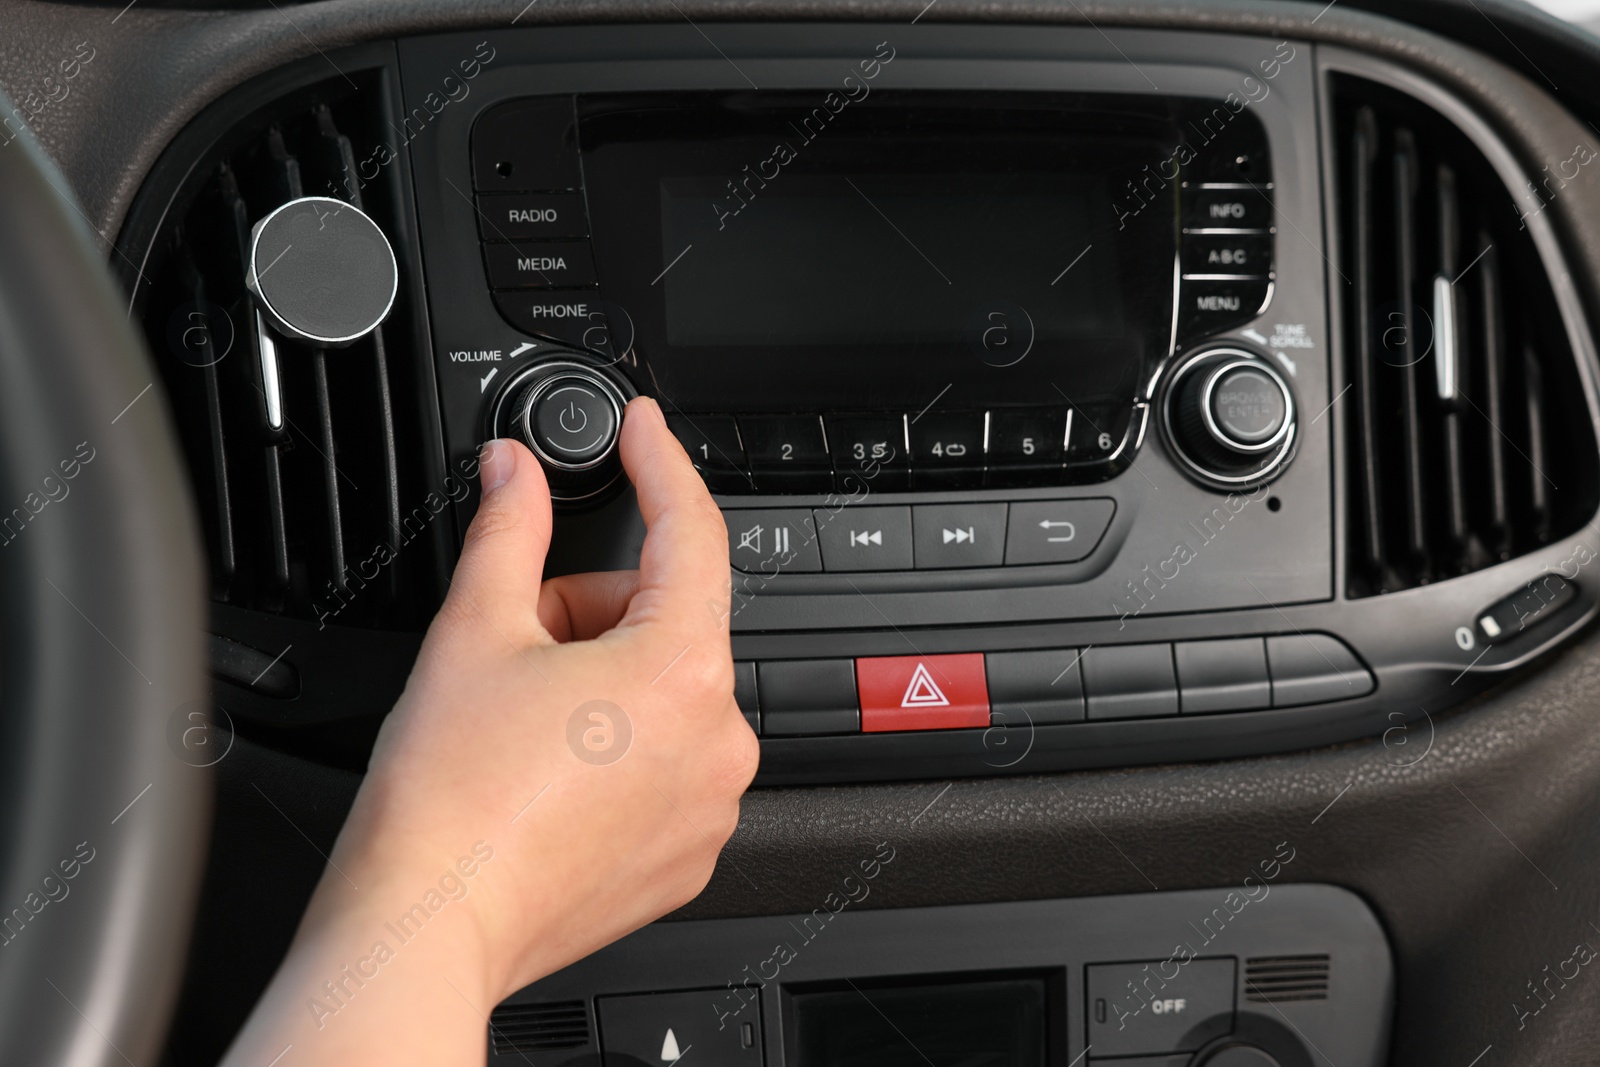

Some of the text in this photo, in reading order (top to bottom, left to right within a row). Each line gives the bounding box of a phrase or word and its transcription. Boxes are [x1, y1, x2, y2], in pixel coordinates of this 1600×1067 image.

[509, 209, 557, 223] RADIO
[1209, 203, 1246, 218] INFO
[517, 257, 567, 271] MEDIA
[532, 304, 588, 318] PHONE
[1197, 296, 1240, 311] MENU
[1274, 324, 1306, 335] TUNE
[1269, 335, 1315, 348] SCROLL
[449, 350, 502, 363] VOLUME
[1227, 405, 1270, 418] ENTER
[1022, 438, 1034, 455] 5
[1099, 432, 1111, 450] 6
[700, 444, 708, 460] 1
[781, 444, 793, 460] 2
[853, 443, 865, 460] 3
[931, 442, 943, 457] 4
[1152, 999, 1186, 1015] OFF
